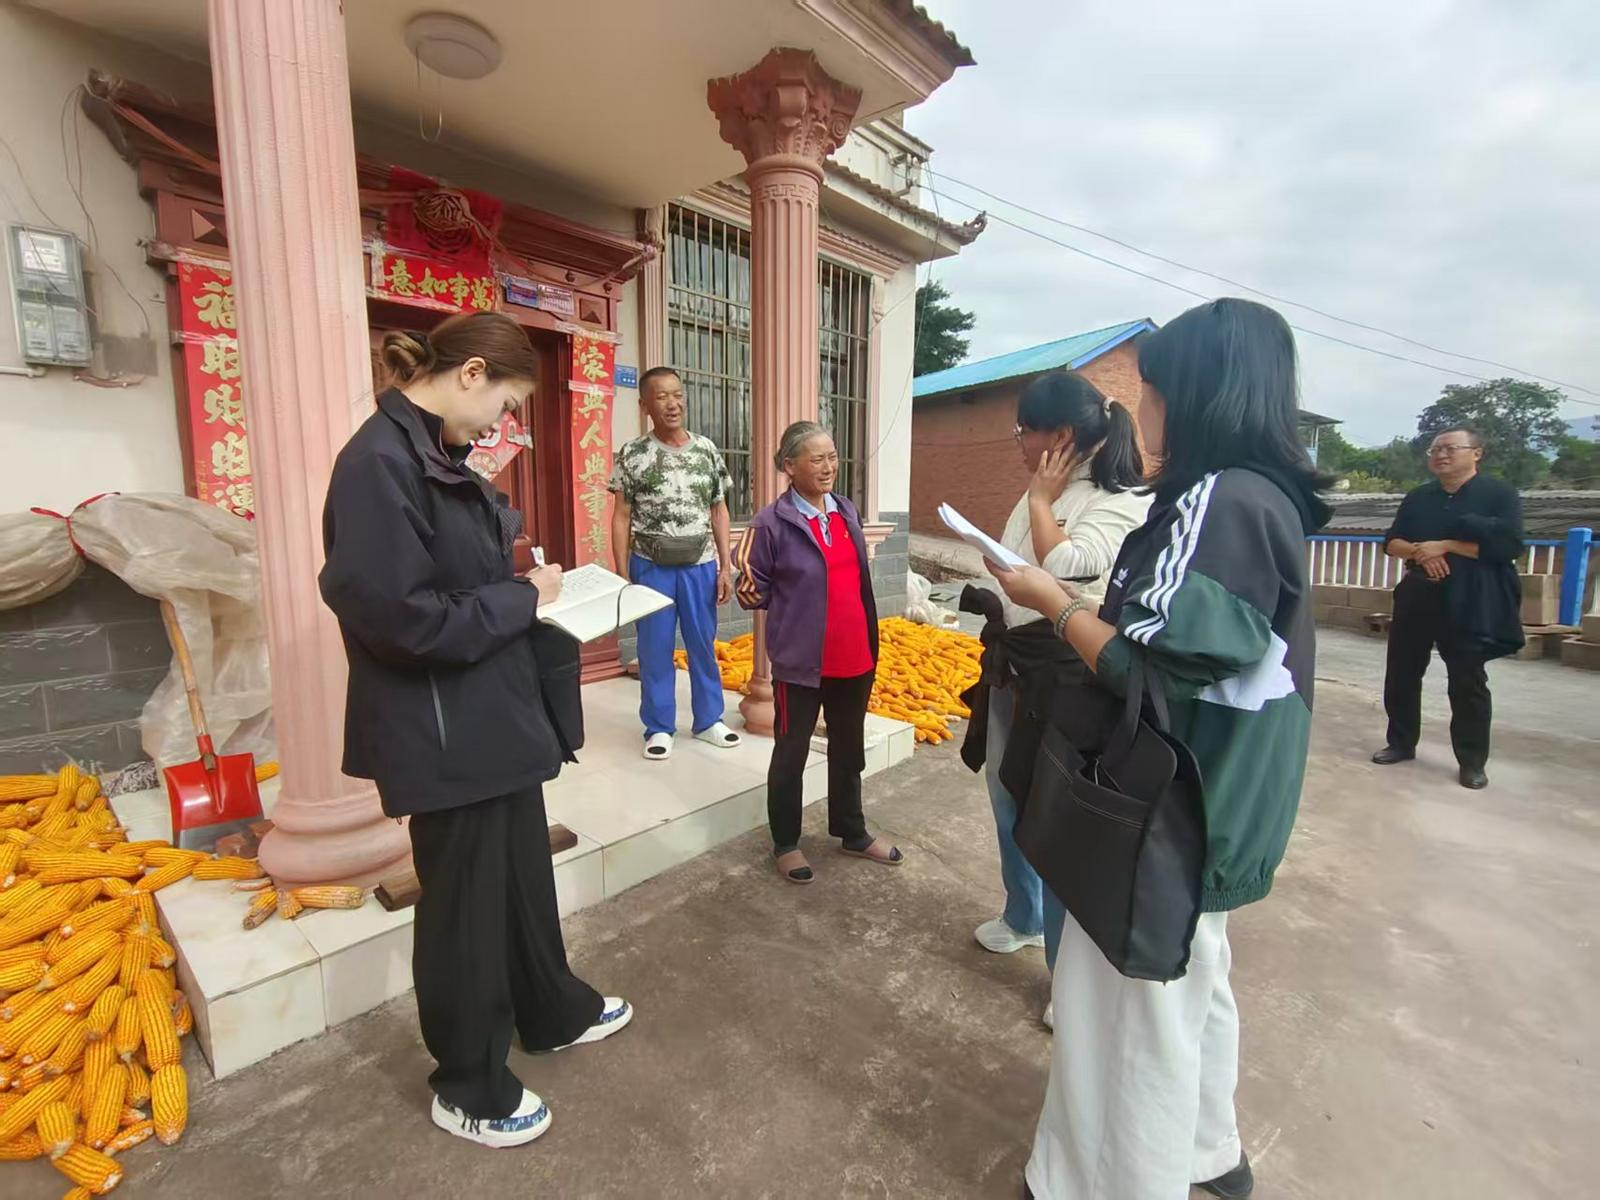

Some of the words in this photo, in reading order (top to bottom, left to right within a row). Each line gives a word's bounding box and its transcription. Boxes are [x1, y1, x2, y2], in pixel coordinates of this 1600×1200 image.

[384, 258, 493, 311] 萬事如意
[577, 345, 610, 568] 家興人興事業
